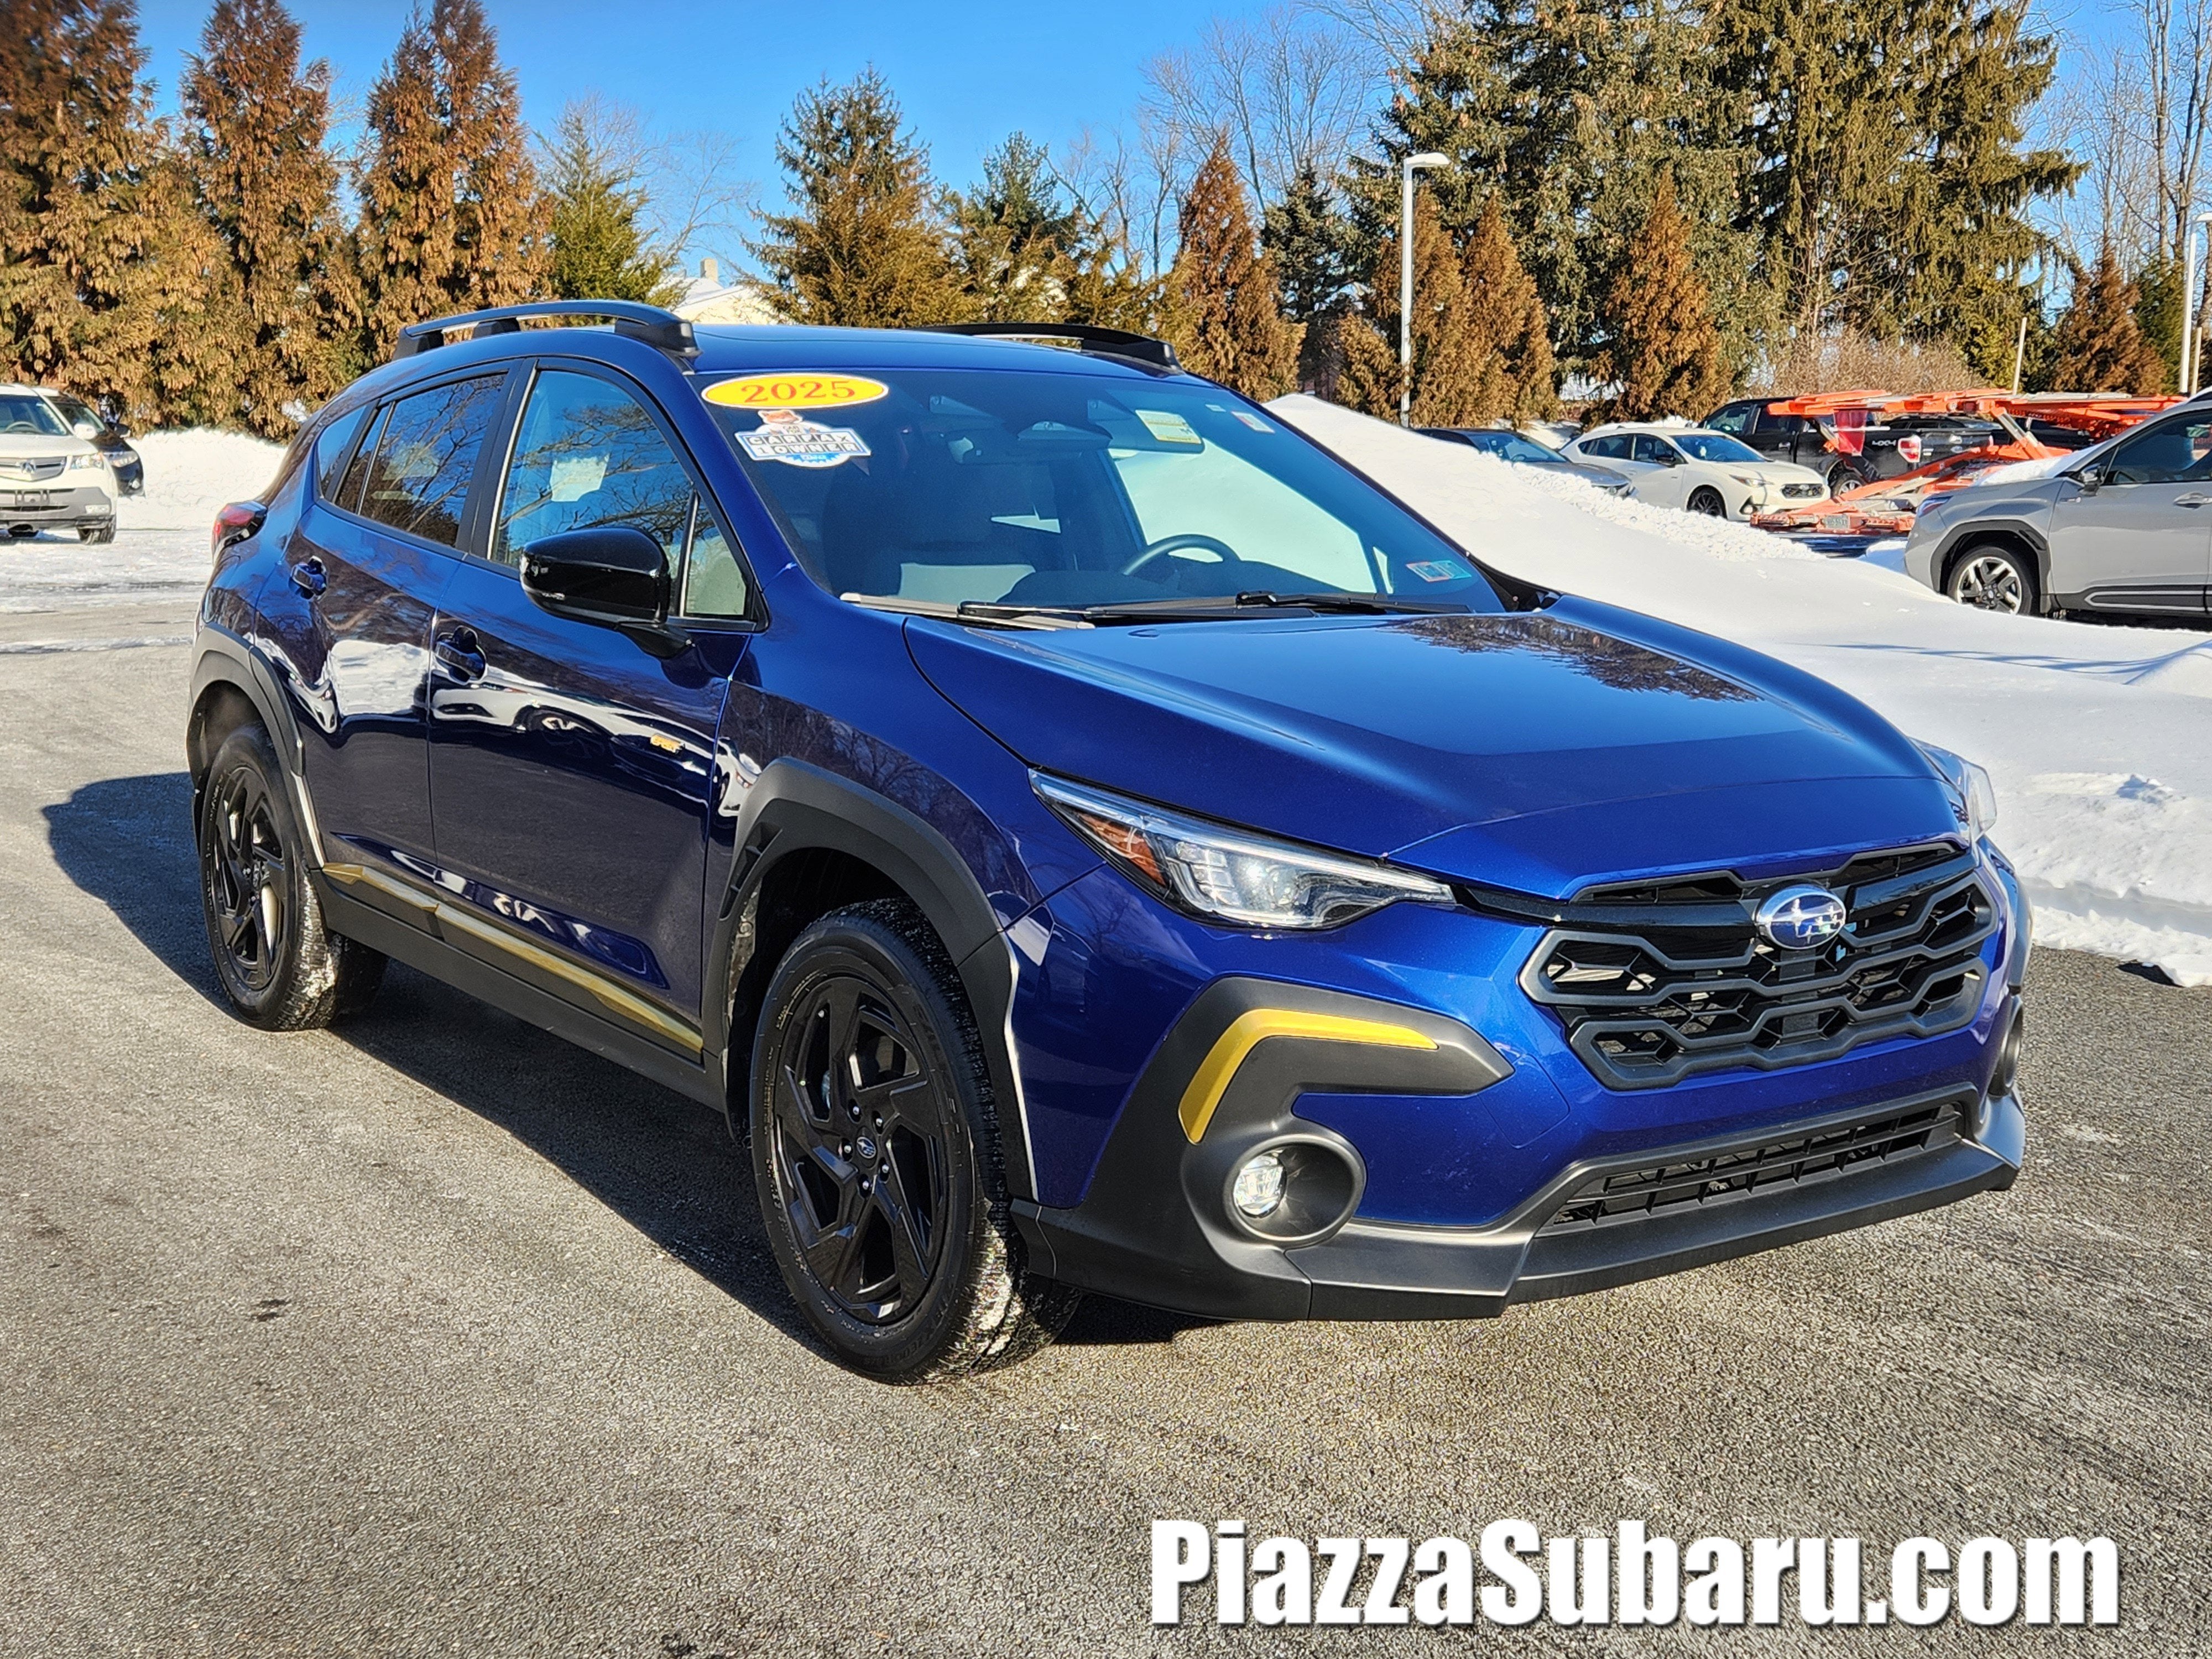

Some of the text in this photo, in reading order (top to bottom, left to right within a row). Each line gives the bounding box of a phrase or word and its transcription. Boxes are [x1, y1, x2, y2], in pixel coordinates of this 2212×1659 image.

[741, 380, 855, 403] 2025
[748, 432, 851, 445] CARFAX
[772, 442, 859, 455] OWNER
